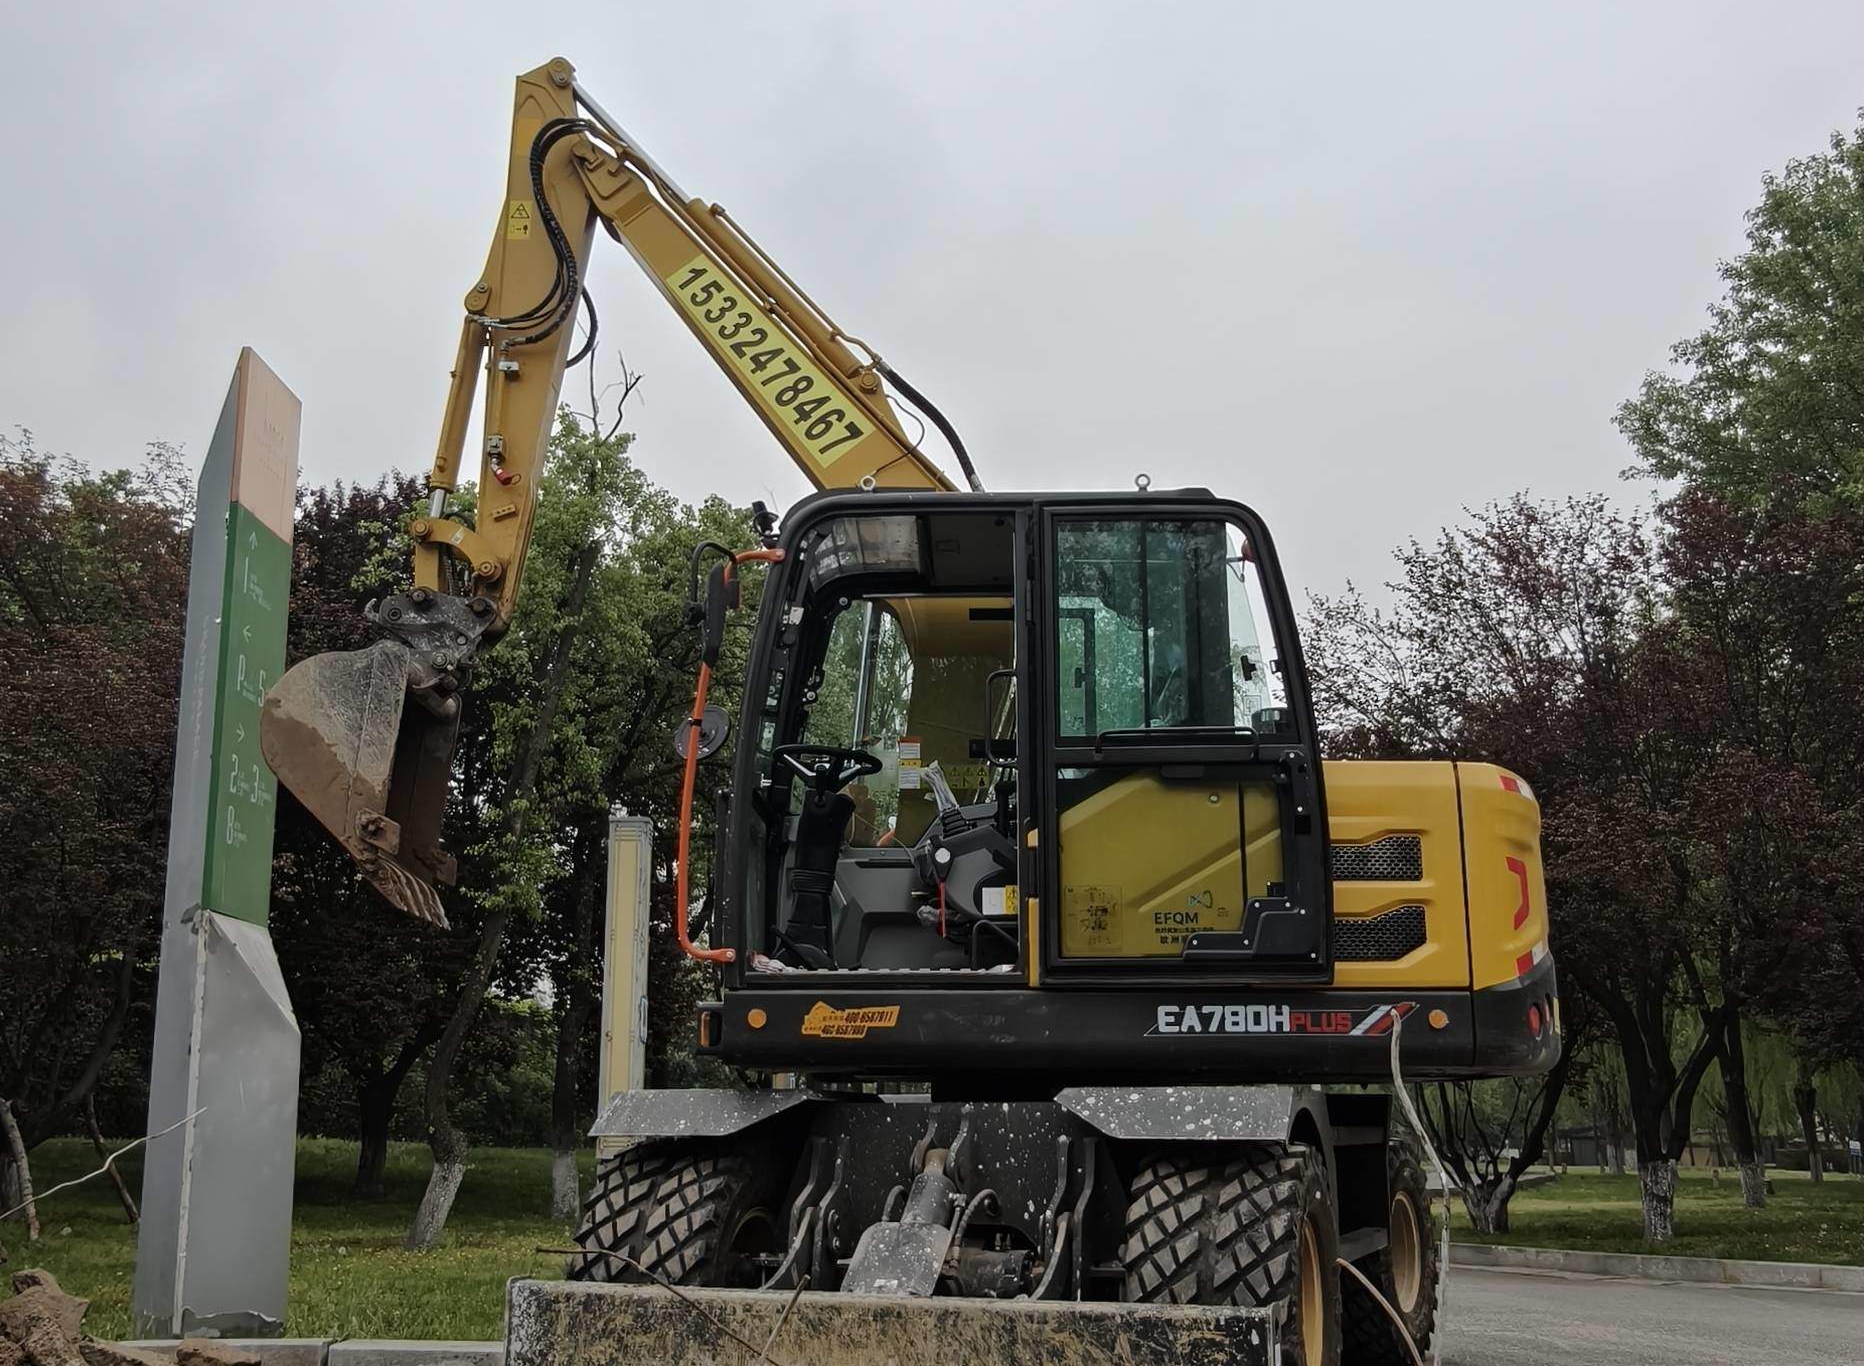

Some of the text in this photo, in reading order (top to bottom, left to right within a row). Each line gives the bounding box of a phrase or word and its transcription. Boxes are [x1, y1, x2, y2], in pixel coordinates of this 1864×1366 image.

[678, 267, 865, 455] 15332478467
[237, 654, 246, 692] P
[229, 753, 239, 794] 2
[250, 764, 260, 804] 3
[1154, 911, 1200, 926] EFQM
[1156, 1004, 1352, 1033] EA780H PLUS
